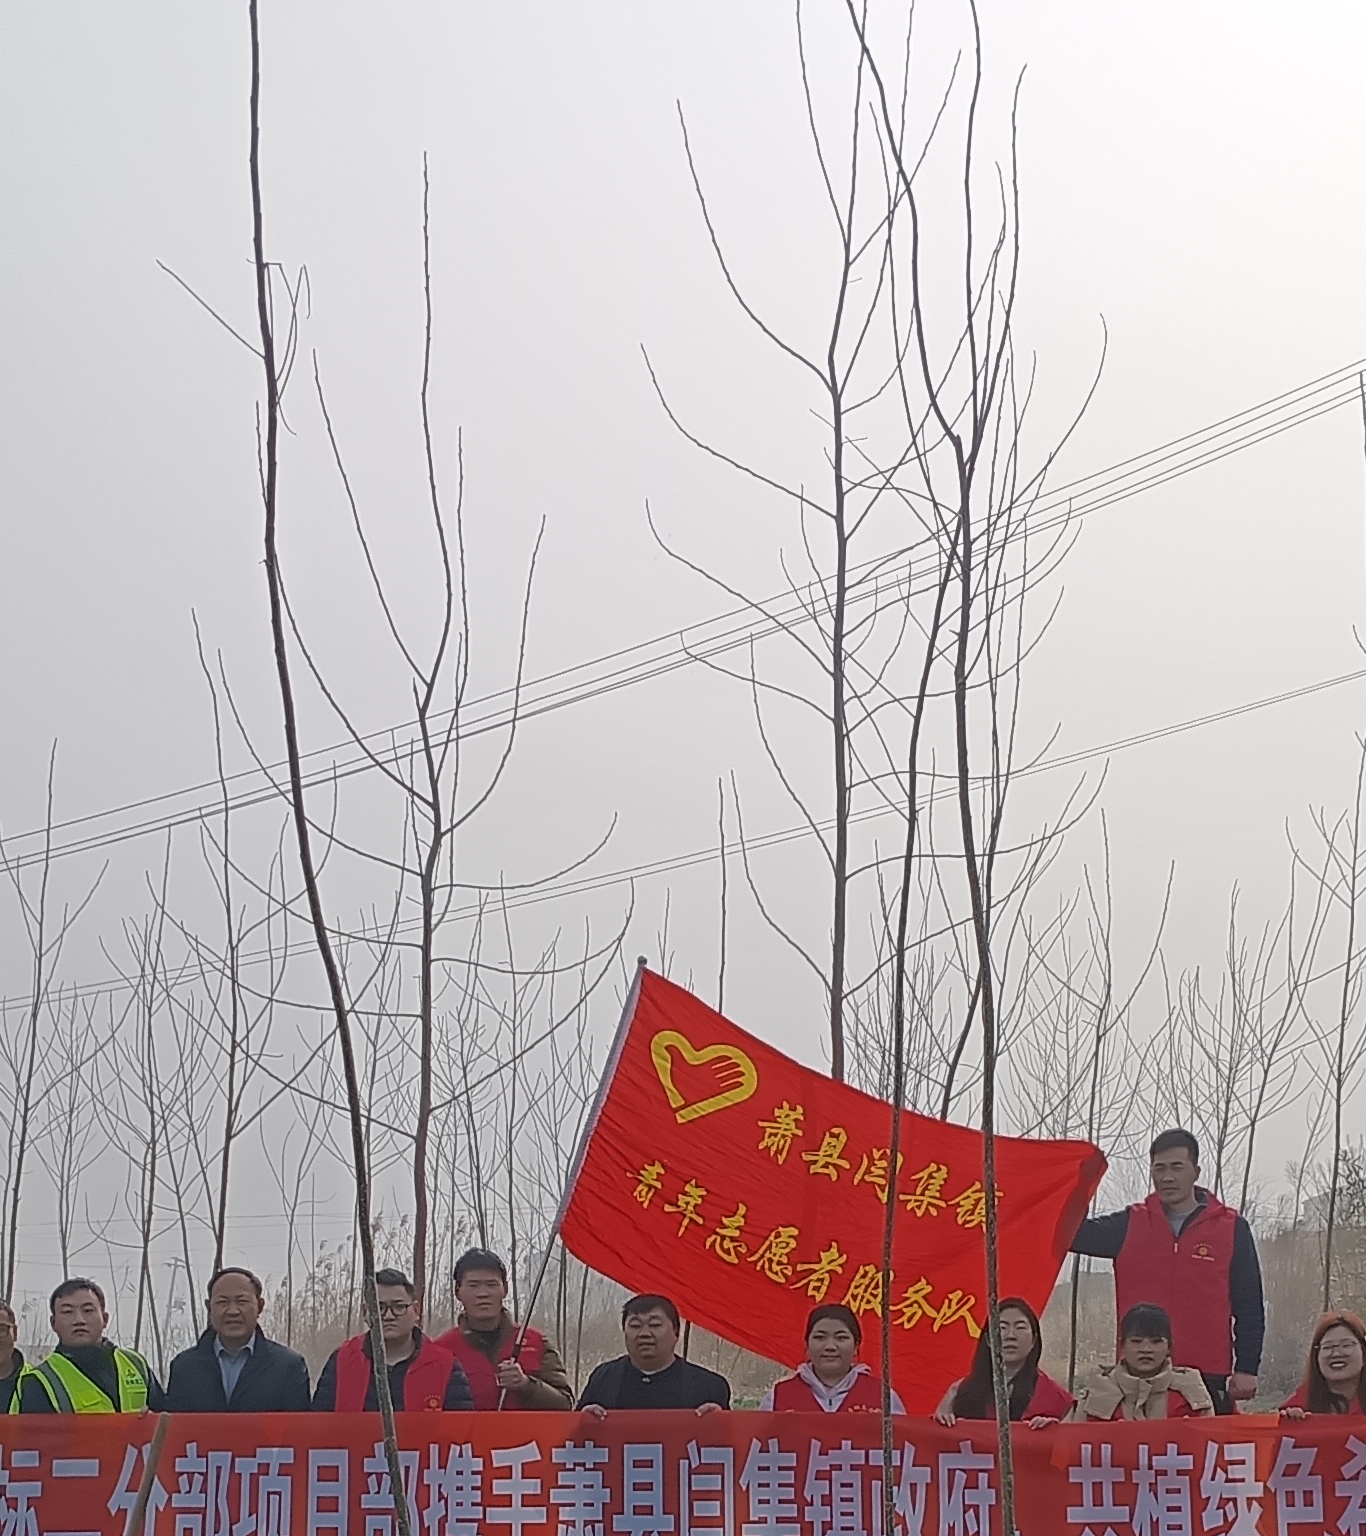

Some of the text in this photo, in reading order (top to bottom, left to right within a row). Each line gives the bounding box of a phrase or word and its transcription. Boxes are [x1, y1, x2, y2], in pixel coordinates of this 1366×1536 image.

[757, 1100, 1004, 1234] 萧县闫集镇
[626, 1159, 982, 1340] 青年志愿者服务队
